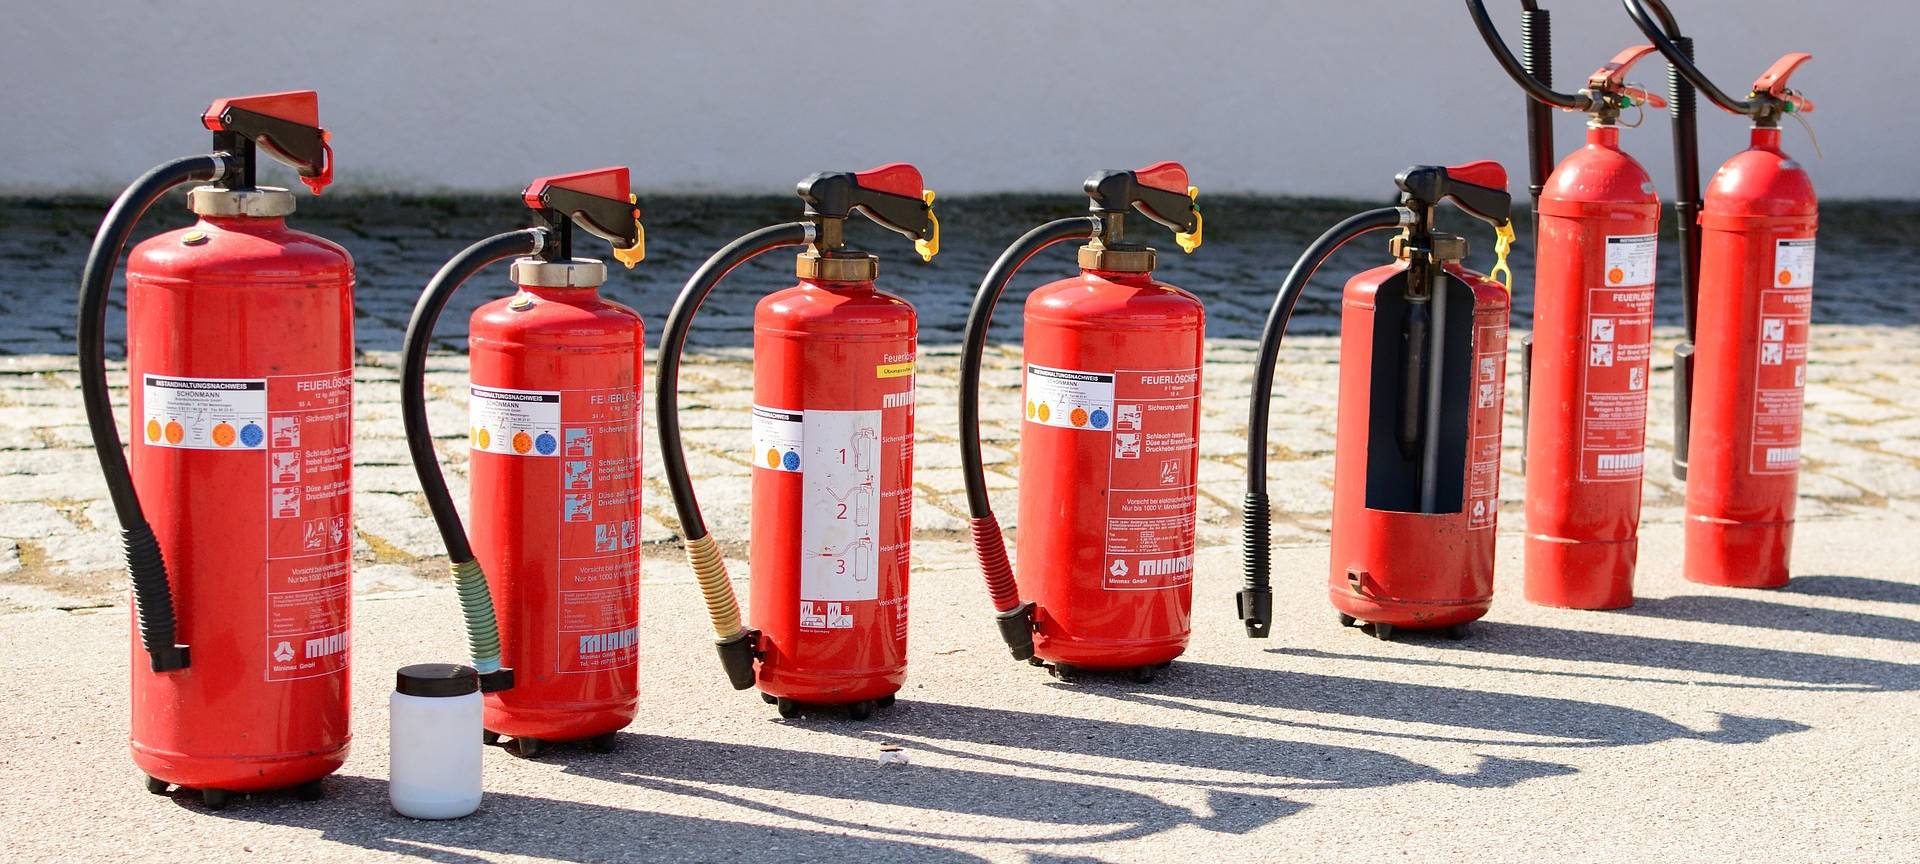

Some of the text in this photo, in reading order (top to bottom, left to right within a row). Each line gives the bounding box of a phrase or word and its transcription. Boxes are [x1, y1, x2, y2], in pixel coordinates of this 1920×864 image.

[1147, 404, 1174, 412] Sicherung
[839, 448, 846, 465] 1
[1172, 462, 1178, 471] A
[837, 503, 848, 520] 2
[318, 521, 325, 532] A
[608, 522, 617, 537] A
[836, 559, 846, 575] 3
